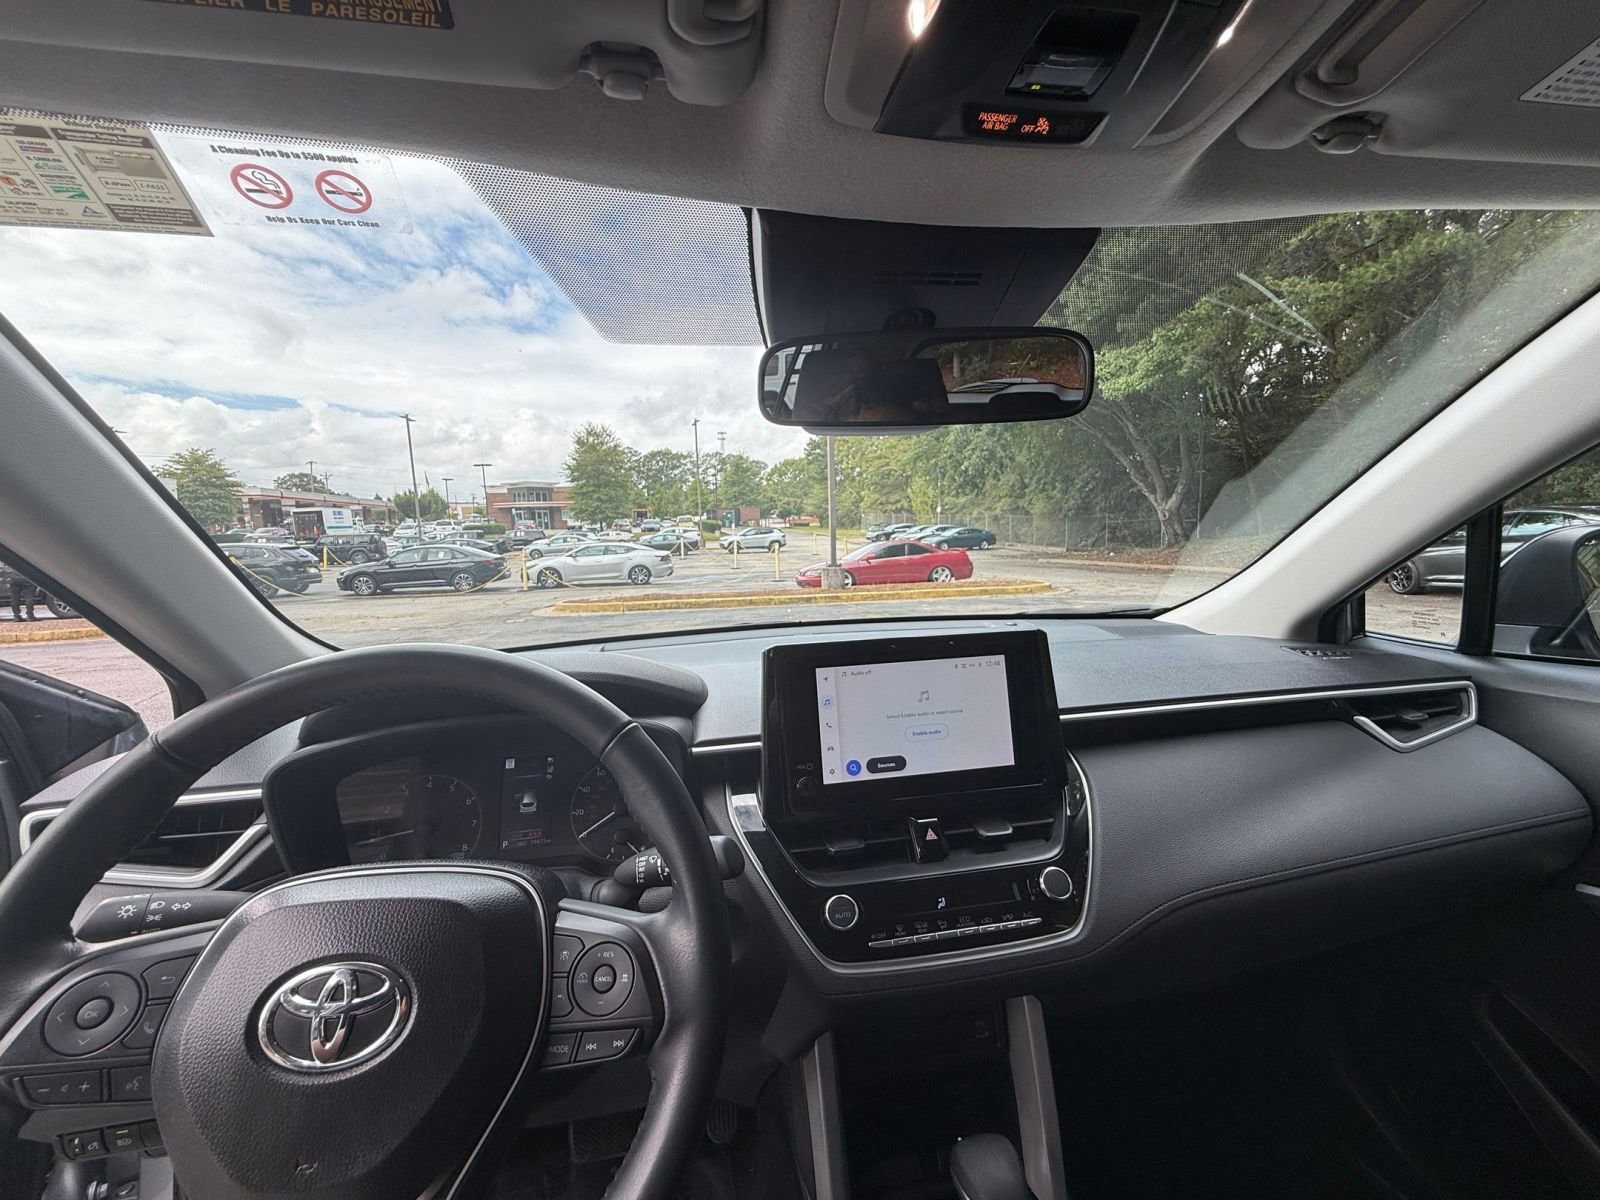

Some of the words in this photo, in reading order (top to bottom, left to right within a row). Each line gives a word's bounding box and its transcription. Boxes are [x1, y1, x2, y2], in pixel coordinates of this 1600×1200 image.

[265, 0, 291, 12] LE
[311, 2, 441, 27] PARESOLEIL
[978, 112, 1018, 123] PASSENGER
[982, 122, 995, 130] AIR
[994, 123, 1009, 131] BAG
[1021, 125, 1036, 134] OFF
[209, 145, 219, 153] A
[217, 145, 261, 157] Cleaning
[259, 148, 278, 158] Fee
[276, 150, 291, 159] Up
[290, 151, 302, 160] to
[301, 151, 326, 161] $500
[325, 155, 359, 164] applies
[265, 215, 286, 224] Help
[286, 216, 299, 224] Us
[298, 216, 321, 225] Keep
[321, 218, 336, 226] Our
[336, 218, 356, 227] Cars
[356, 220, 380, 228] Clean
[900, 711, 916, 719] Enable
[596, 769, 606, 777] 60
[448, 783, 456, 792] 5
[575, 808, 585, 817] 20
[471, 819, 478, 828] 7
[461, 843, 469, 852] 8
[502, 840, 509, 849] P
[835, 911, 852, 919] AUTO
[594, 975, 613, 983] CANCEL
[84, 1010, 99, 1019] OK
[549, 1045, 569, 1054] MODE
